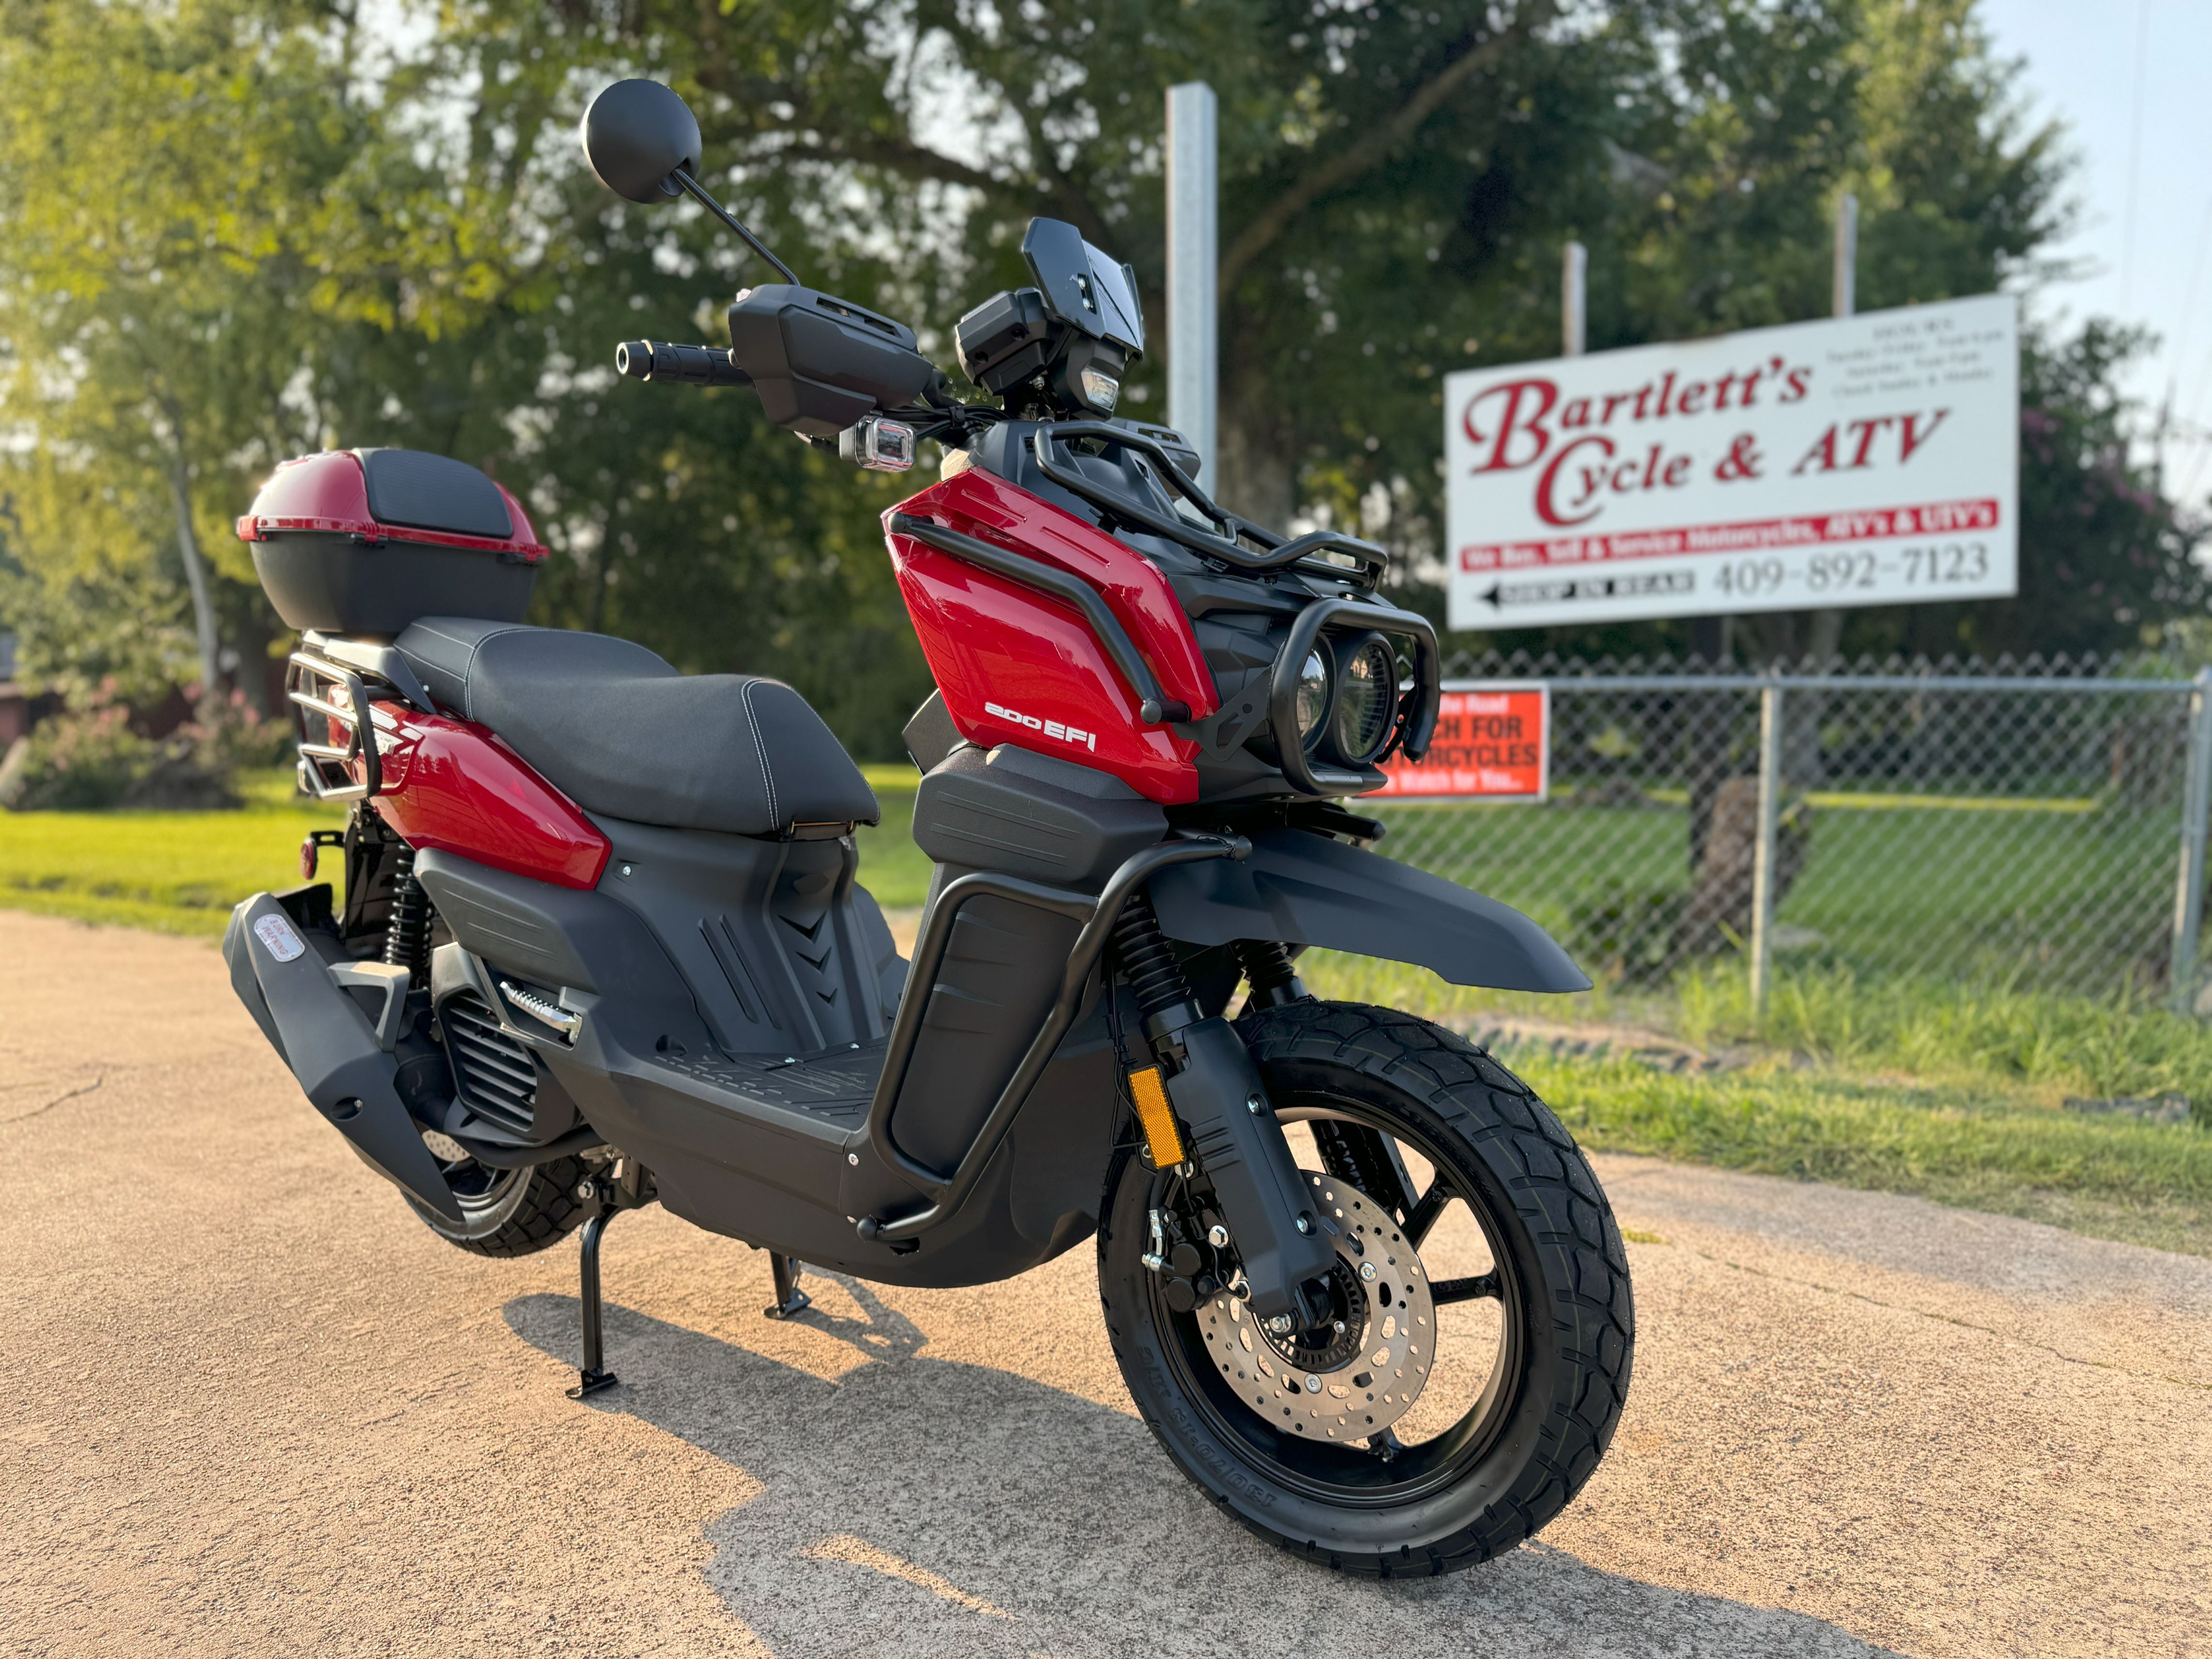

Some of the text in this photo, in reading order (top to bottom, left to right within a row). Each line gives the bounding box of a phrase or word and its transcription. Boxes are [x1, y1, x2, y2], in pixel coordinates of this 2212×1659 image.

[1463, 355, 1812, 476] Bartlett's
[1534, 407, 1952, 527] Cycle & ATV
[1894, 507, 1915, 531] &
[1714, 543, 1988, 596] 409-892-7123
[1472, 715, 1523, 739] FOR
